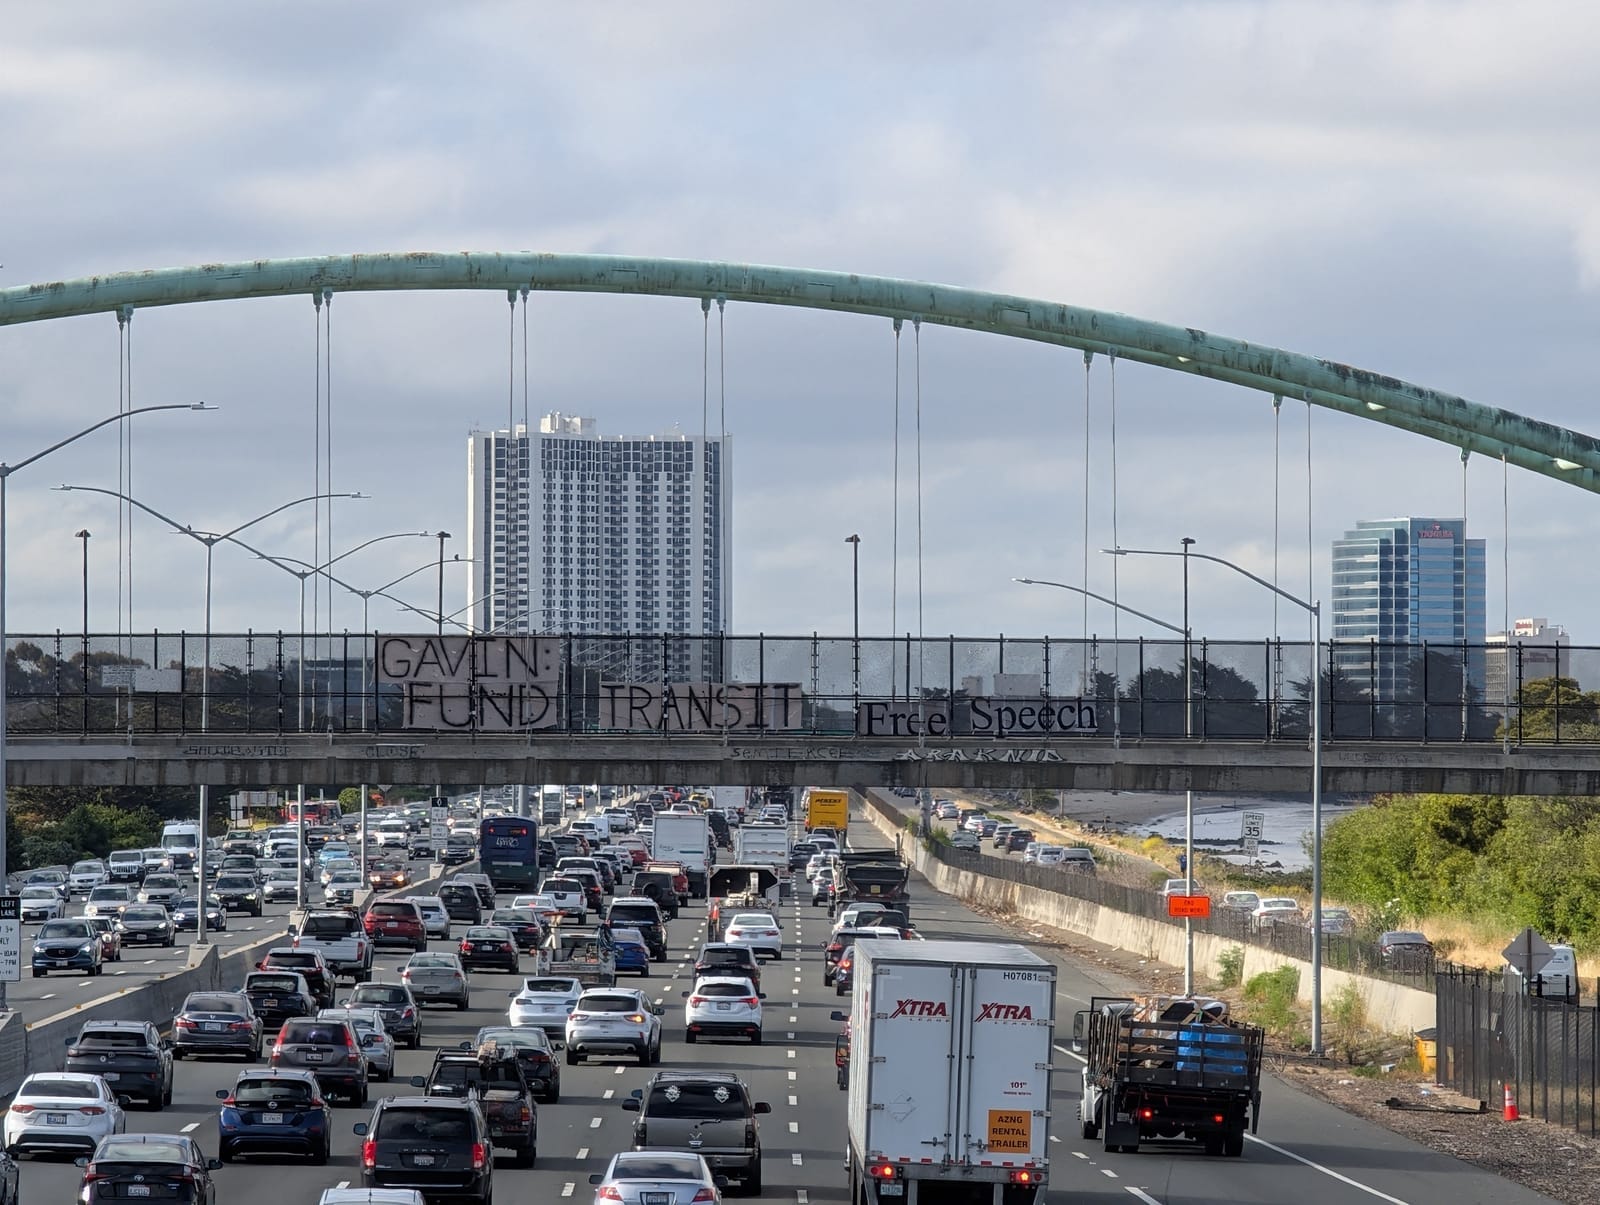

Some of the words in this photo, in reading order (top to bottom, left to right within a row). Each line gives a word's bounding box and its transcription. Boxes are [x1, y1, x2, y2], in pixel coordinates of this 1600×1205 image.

[381, 638, 551, 678] GAVIN:
[407, 682, 550, 728] FUND
[601, 683, 800, 730] TRANSIT
[862, 702, 947, 736] Free
[971, 697, 1098, 737] Speech
[1244, 826, 1260, 837] 35
[0, 900, 15, 908] LEFT
[0, 909, 16, 917] LANE
[1003, 971, 1038, 981] H07081
[889, 999, 947, 1019] XTRA
[974, 1002, 1033, 1022] XTRA
[997, 1115, 1023, 1124] AZNG
[992, 1127, 1027, 1136] RENTAL
[990, 1139, 1028, 1148] TRAILER
